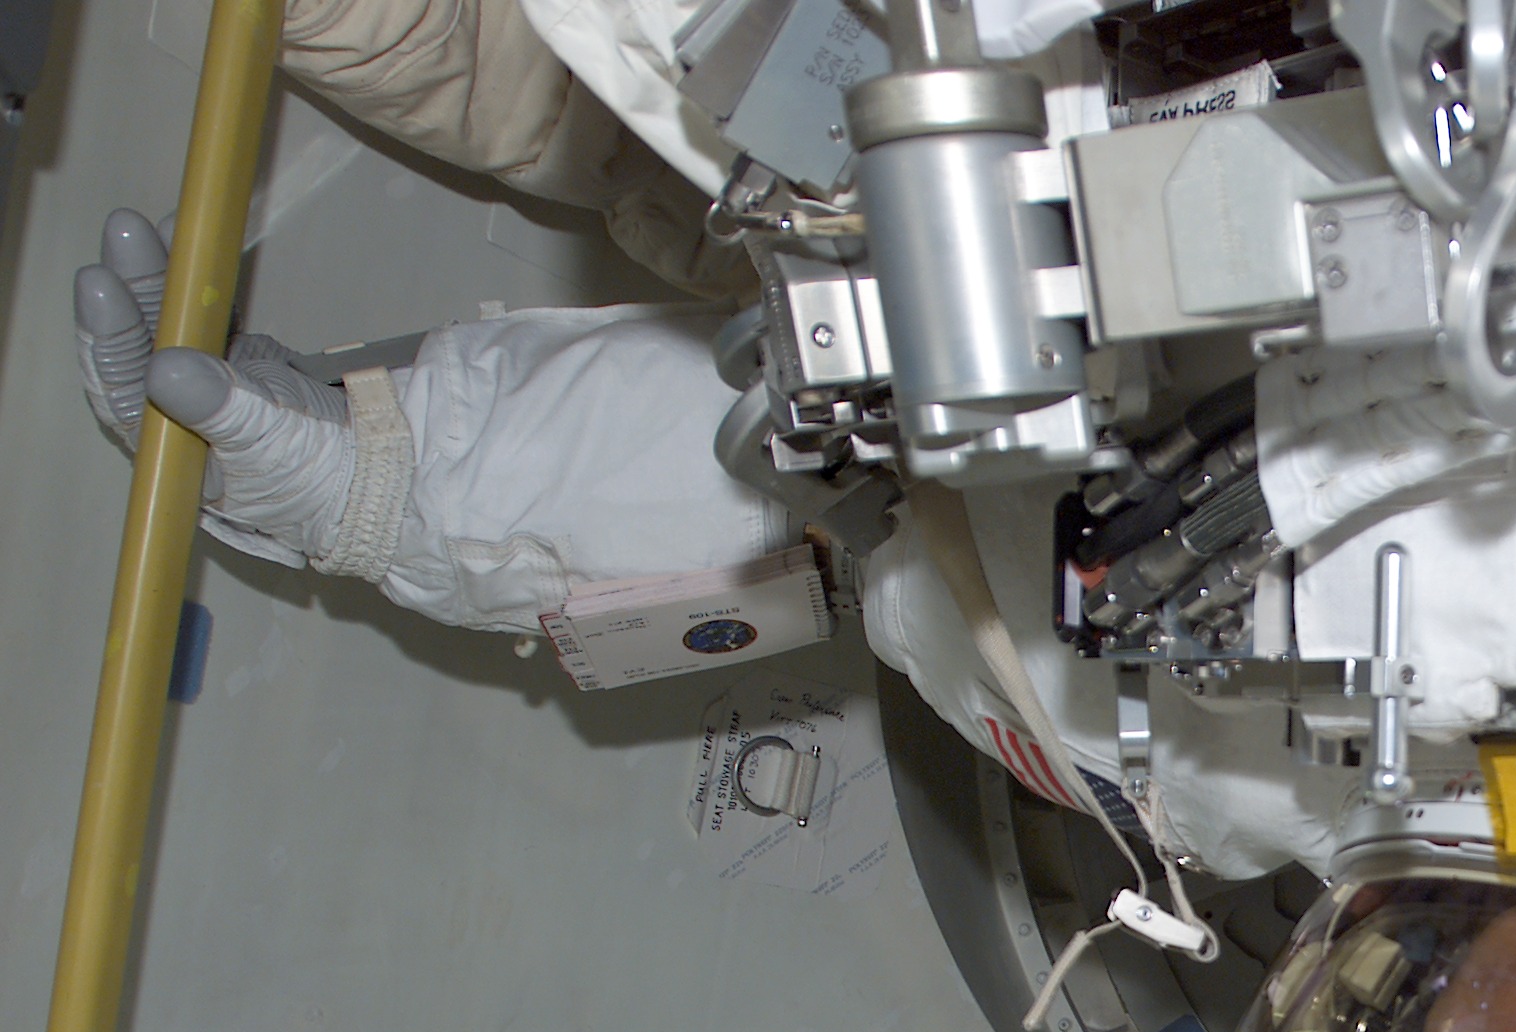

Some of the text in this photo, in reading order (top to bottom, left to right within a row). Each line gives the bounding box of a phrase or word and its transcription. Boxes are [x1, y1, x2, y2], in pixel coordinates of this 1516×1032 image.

[689, 607, 740, 620] STS-109
[696, 726, 716, 803] PULL HERE
[712, 804, 724, 832] SEAT
[718, 749, 735, 799] STOWAGE
[728, 710, 742, 743] STRAP
